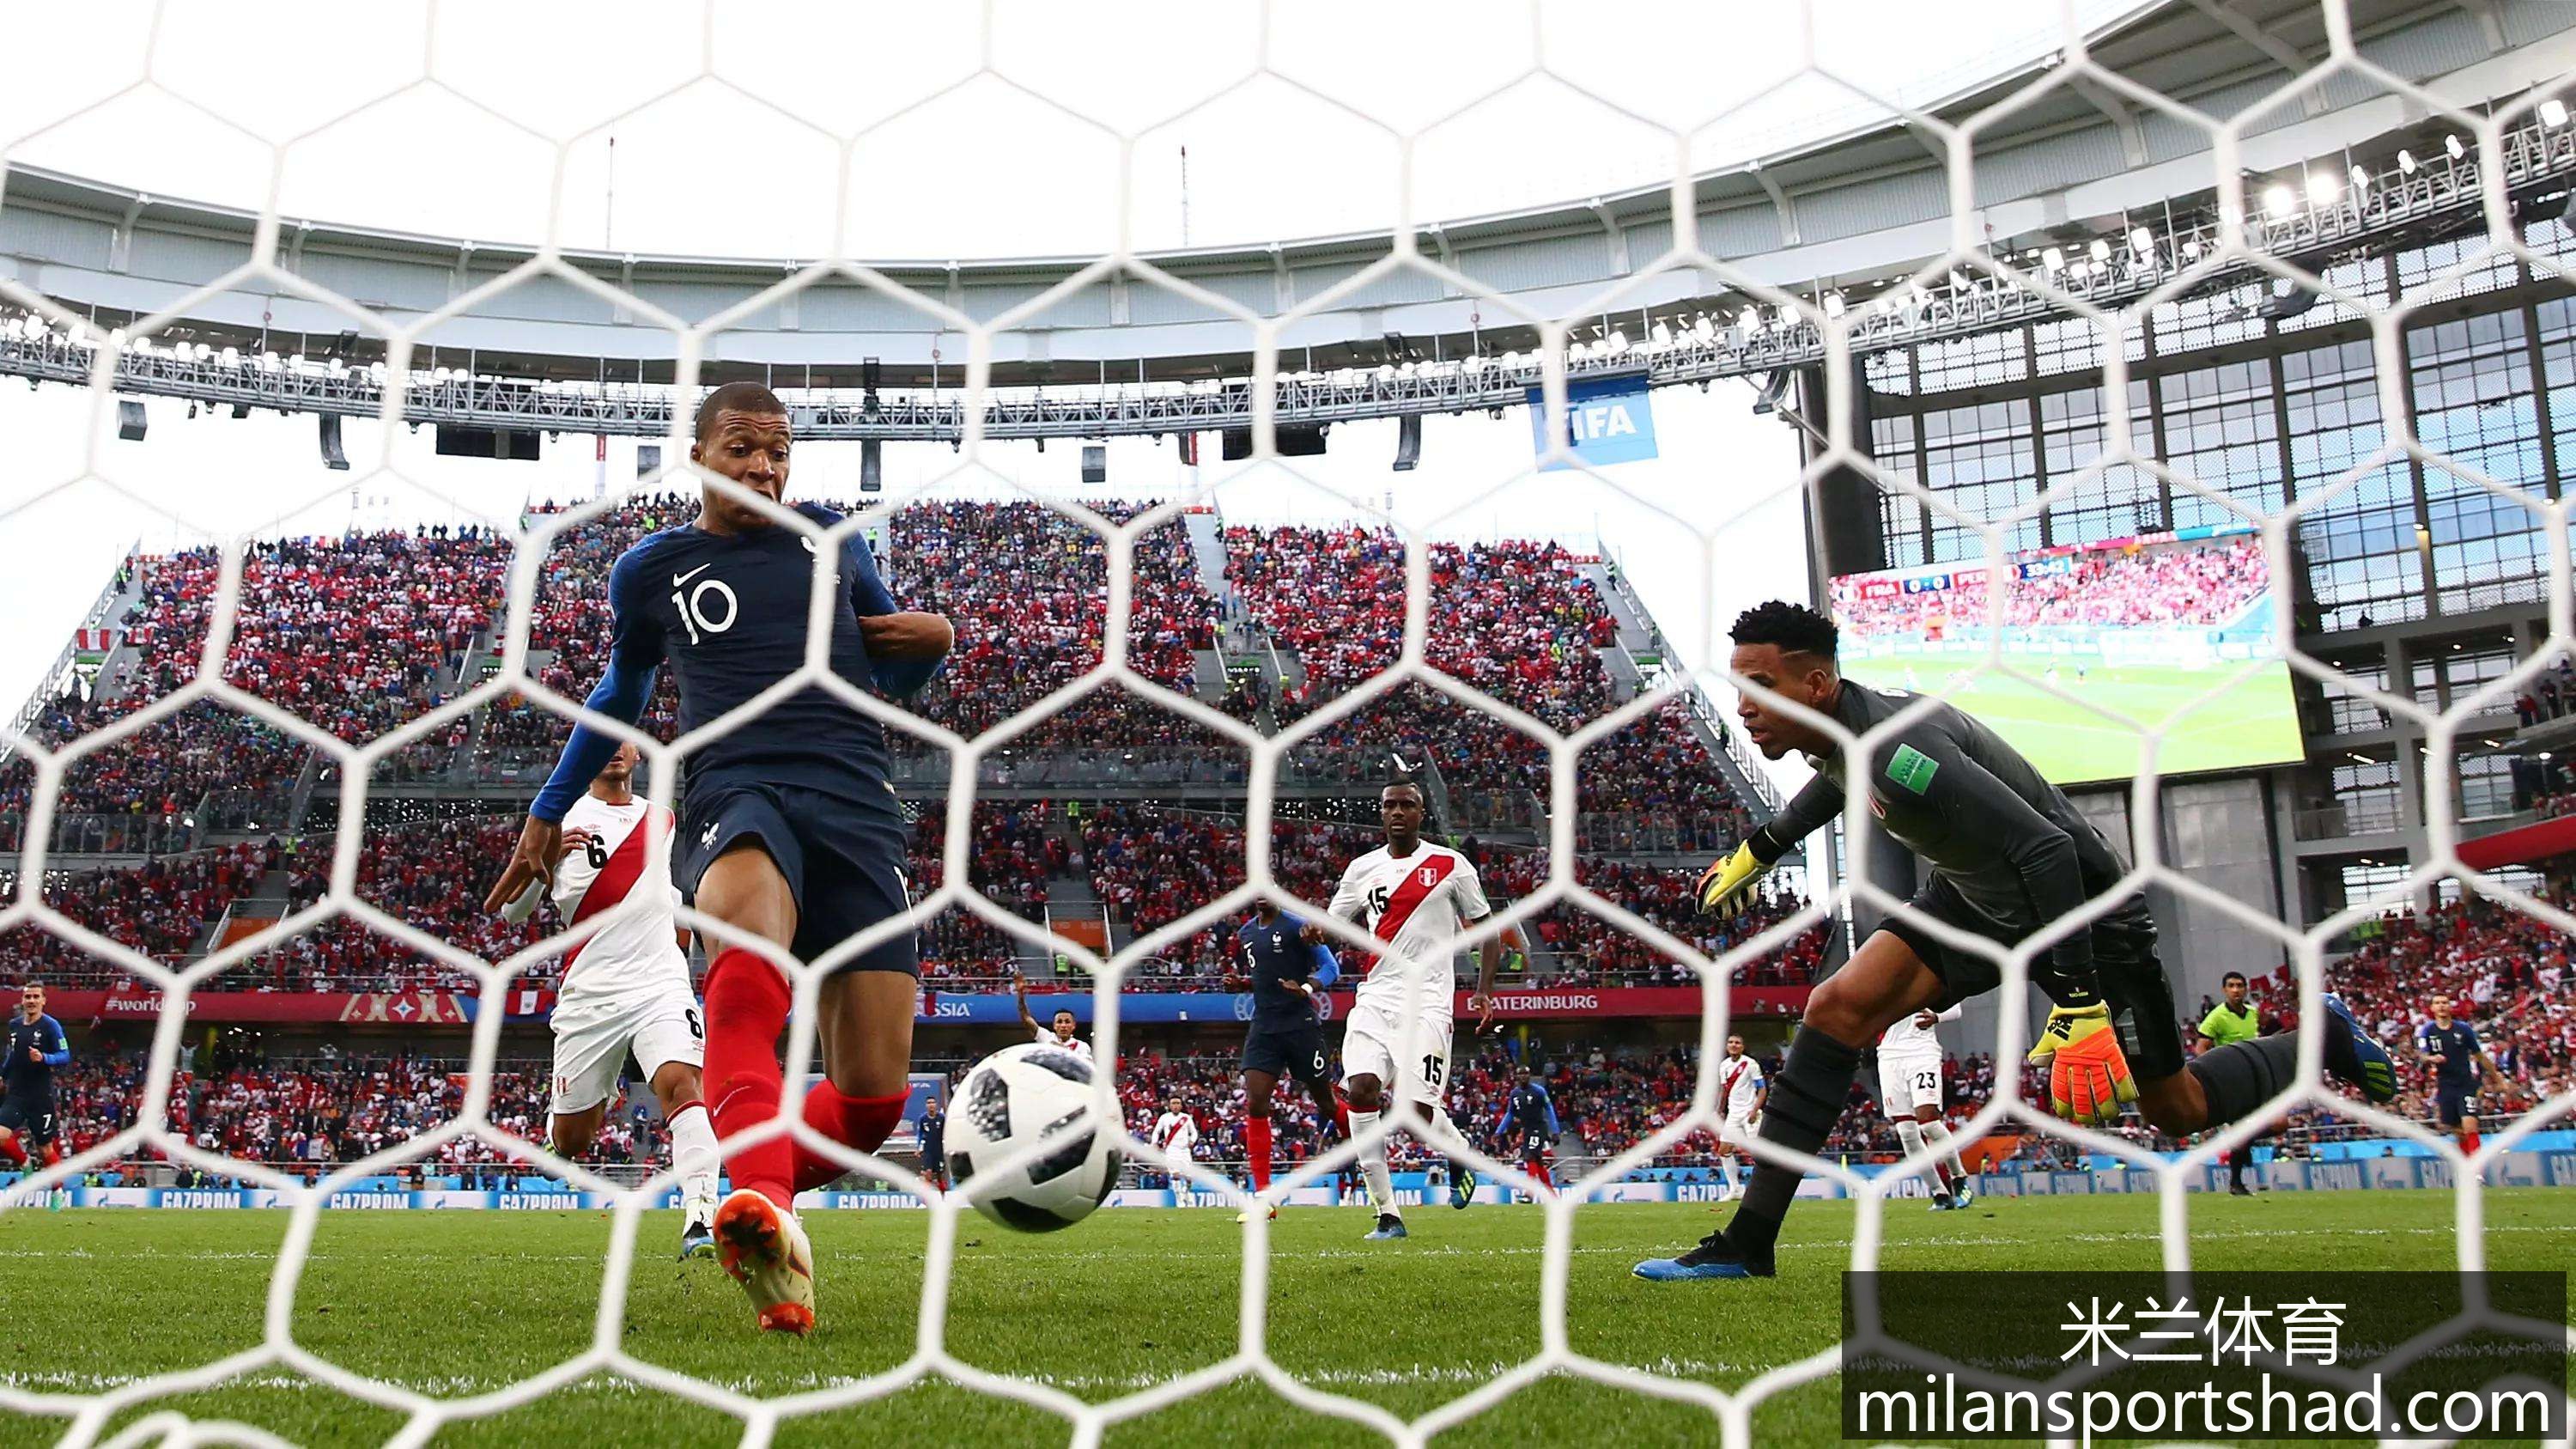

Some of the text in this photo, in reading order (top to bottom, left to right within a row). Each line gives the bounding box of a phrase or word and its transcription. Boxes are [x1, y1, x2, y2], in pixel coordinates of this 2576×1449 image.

[1564, 405, 1637, 441] IFA
[1866, 583, 1896, 596] FRA
[671, 579, 738, 645] 10
[586, 834, 608, 869] 6
[1368, 886, 1390, 916] 15
[1247, 948, 1256, 969] 6
[105, 996, 197, 1016] #worldp
[1467, 995, 1598, 1011] EATERINBURG
[1313, 1050, 1325, 1070] 6
[1422, 1054, 1443, 1086] 15
[1916, 1072, 1936, 1089] 23
[43, 1114, 52, 1129] 7
[161, 1192, 241, 1209] GAZPROM
[331, 1194, 410, 1209] GAZPROM
[500, 1194, 579, 1209] GAZPROM
